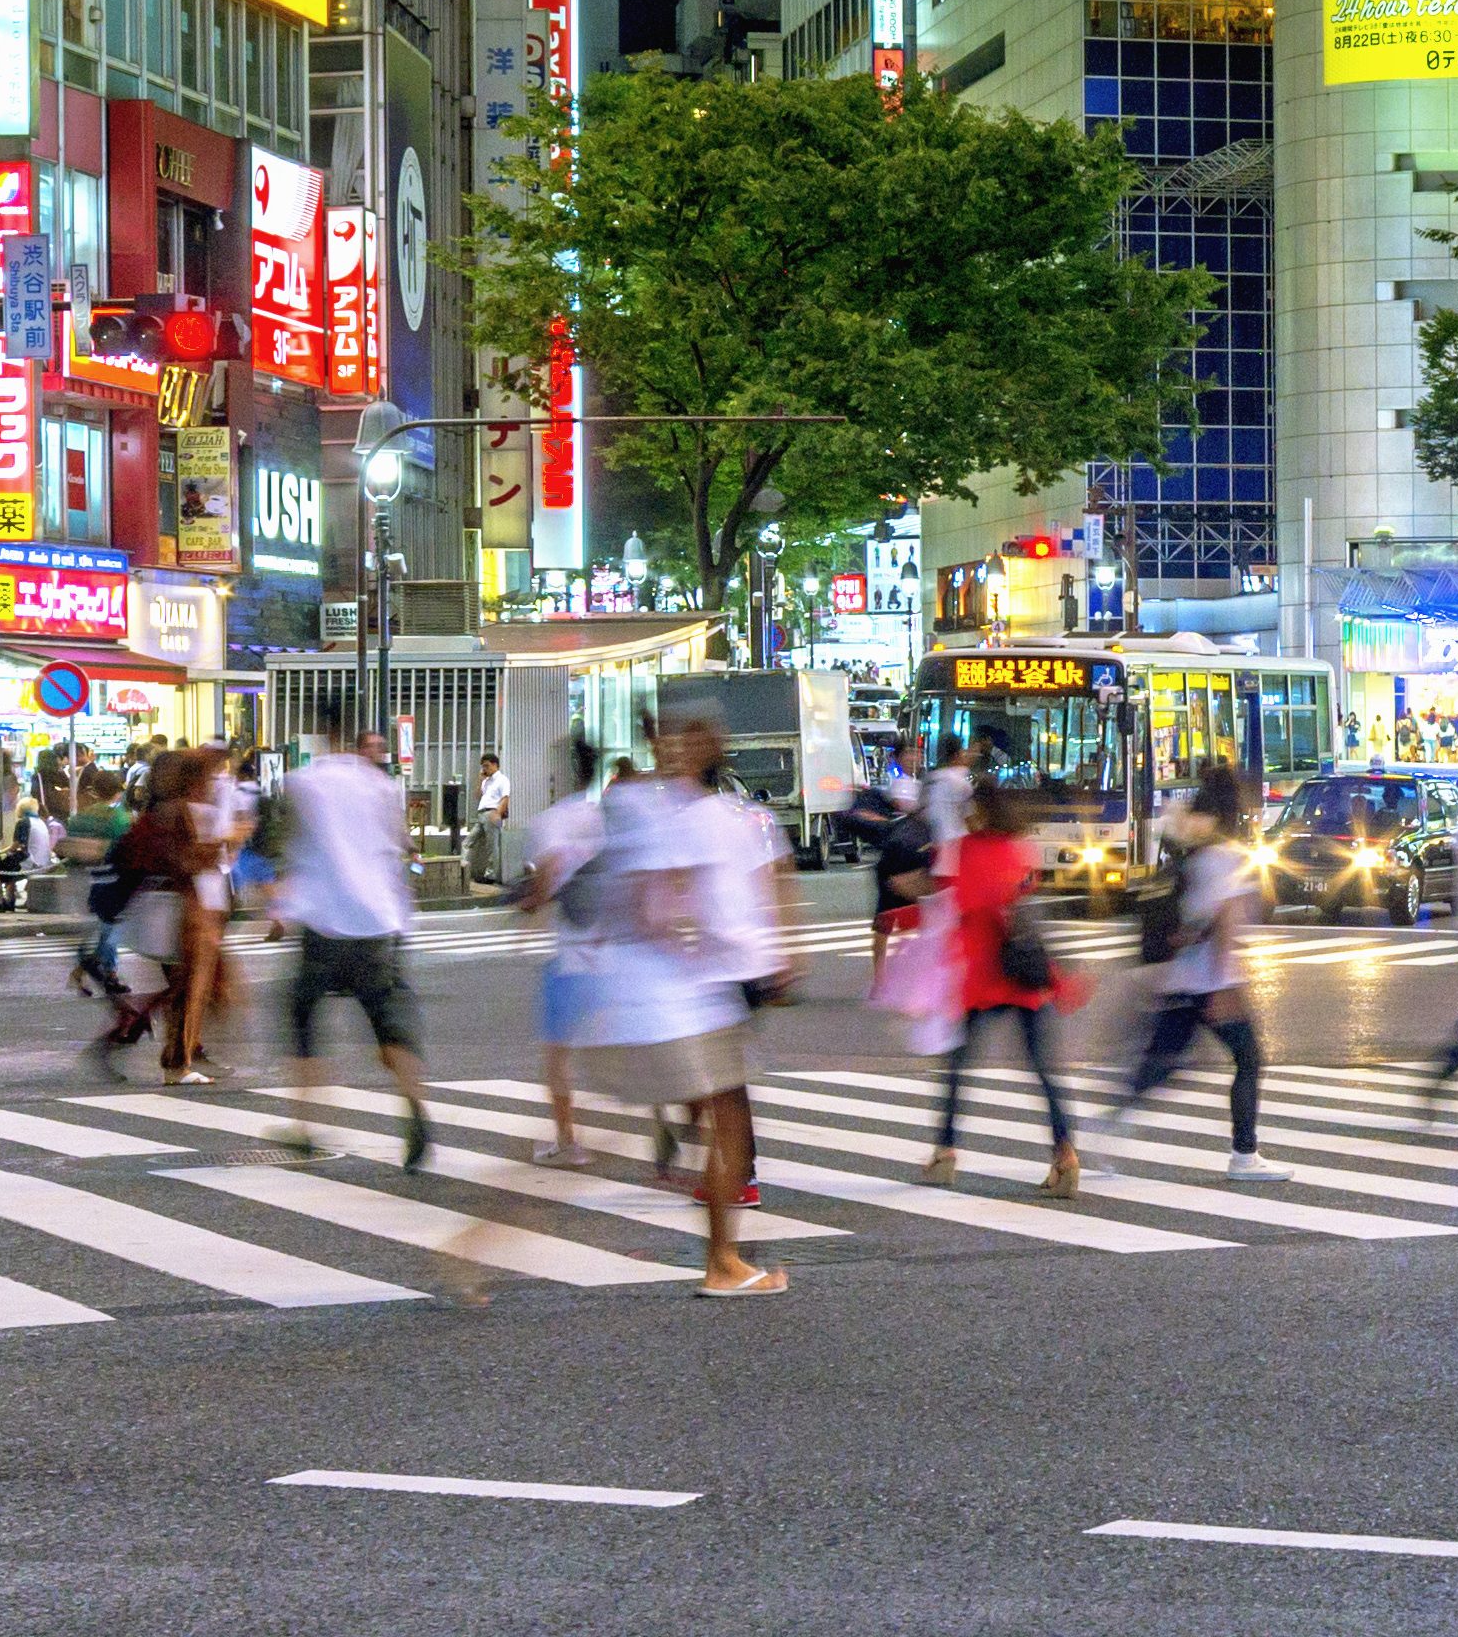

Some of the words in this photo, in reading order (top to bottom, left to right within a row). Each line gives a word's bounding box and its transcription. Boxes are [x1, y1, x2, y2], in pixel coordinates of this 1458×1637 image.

[9, 260, 21, 308] Shibuya
[255, 241, 308, 311] アコム
[23, 244, 46, 349] 渋谷駅前
[11, 313, 22, 333] Sta
[333, 286, 358, 356] アコム
[273, 329, 291, 365] 3F
[337, 364, 356, 378] 3F
[185, 435, 223, 447] ELIJAH
[326, 607, 357, 617] LUSH
[326, 617, 357, 625] FRESH
[987, 668, 1085, 684] 渋谷駅
